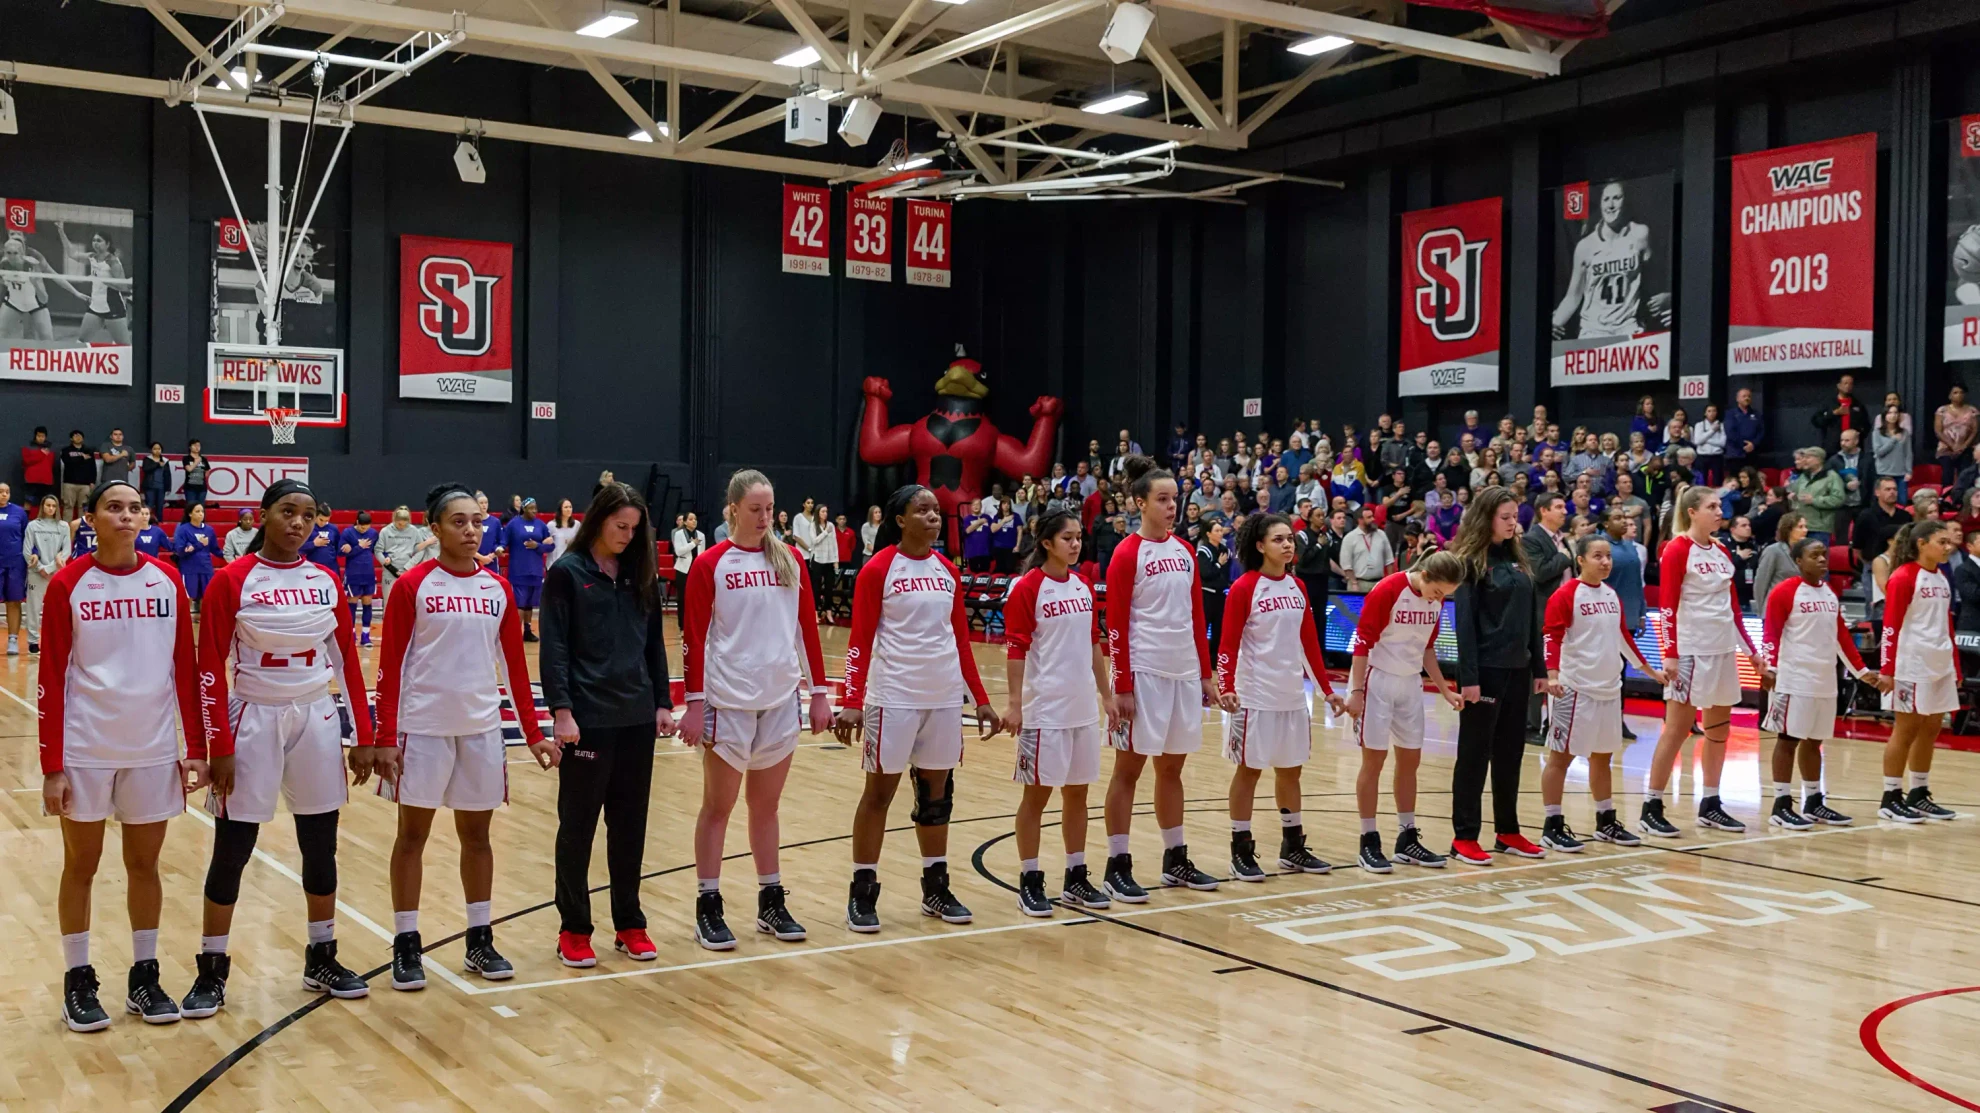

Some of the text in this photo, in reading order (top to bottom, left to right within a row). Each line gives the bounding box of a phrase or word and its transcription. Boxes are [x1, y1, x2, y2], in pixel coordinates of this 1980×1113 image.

[1768, 157, 1834, 192] WAC
[792, 190, 821, 204] WHITE
[853, 198, 887, 211] STIMAC
[913, 205, 945, 218] TURINA
[1740, 190, 1862, 235] CHAMPIONS
[789, 205, 824, 248] 42
[853, 213, 886, 256] 33
[913, 221, 945, 262] 44
[789, 259, 823, 271] 1991-94
[852, 265, 886, 278] 1979-82
[1768, 253, 1829, 296] 2013
[913, 272, 945, 284] 1978-81
[1415, 228, 1489, 341] SU
[418, 255, 503, 356] SU
[1565, 344, 1660, 377] REDHAWKS
[1733, 338, 1865, 364] WOMEN'S BASKETBALL
[10, 348, 120, 375] REDHAWKS
[437, 377, 477, 393] WAC
[1430, 368, 1467, 387] WAC
[159, 389, 181, 402] 105
[1683, 382, 1705, 397] 108
[535, 406, 553, 418] 106
[1245, 403, 1259, 416] 107
[140, 535, 153, 544] W
[1145, 557, 1191, 577] SEATTLEU
[725, 570, 788, 591] SEATTLE
[893, 577, 952, 594] SEATTLEU
[250, 588, 330, 607] SEATTLEU
[425, 595, 500, 618] SEATTLEU
[1257, 596, 1304, 614] SEATTLEU
[79, 598, 170, 621] SEATTLEU
[199, 671, 220, 741] Redhawks
[1229, 863, 1665, 922] LEARN COMPETE INSPIRE
[1253, 872, 1877, 981] WAC
